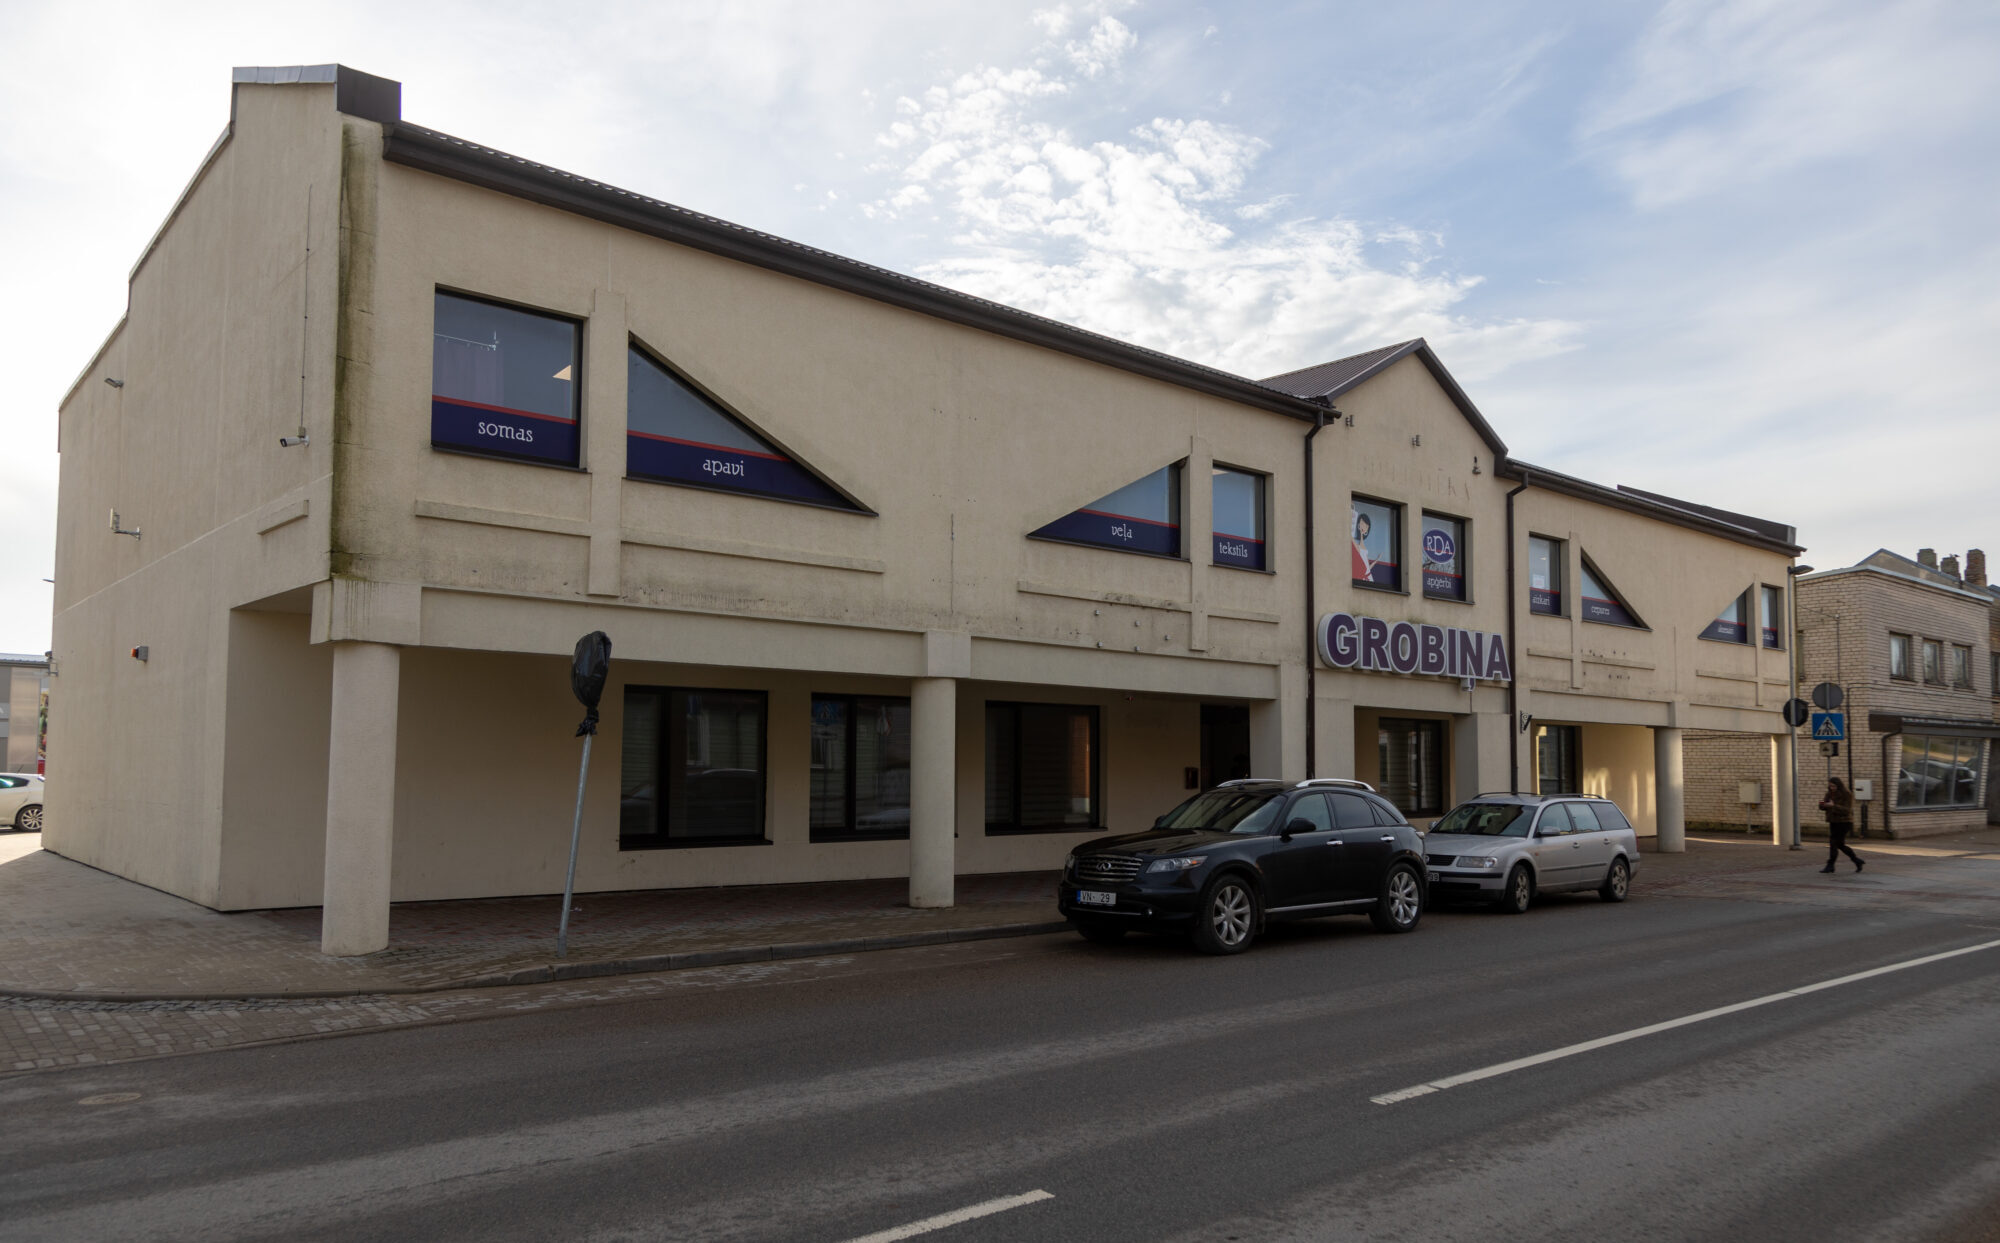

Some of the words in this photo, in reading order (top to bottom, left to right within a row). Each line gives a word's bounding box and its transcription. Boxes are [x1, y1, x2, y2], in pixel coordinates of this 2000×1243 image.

[478, 421, 533, 442] somas
[702, 459, 745, 477] apavi
[1111, 523, 1133, 541] veļa
[1219, 542, 1249, 558] tekstils
[1426, 535, 1453, 555] RDA
